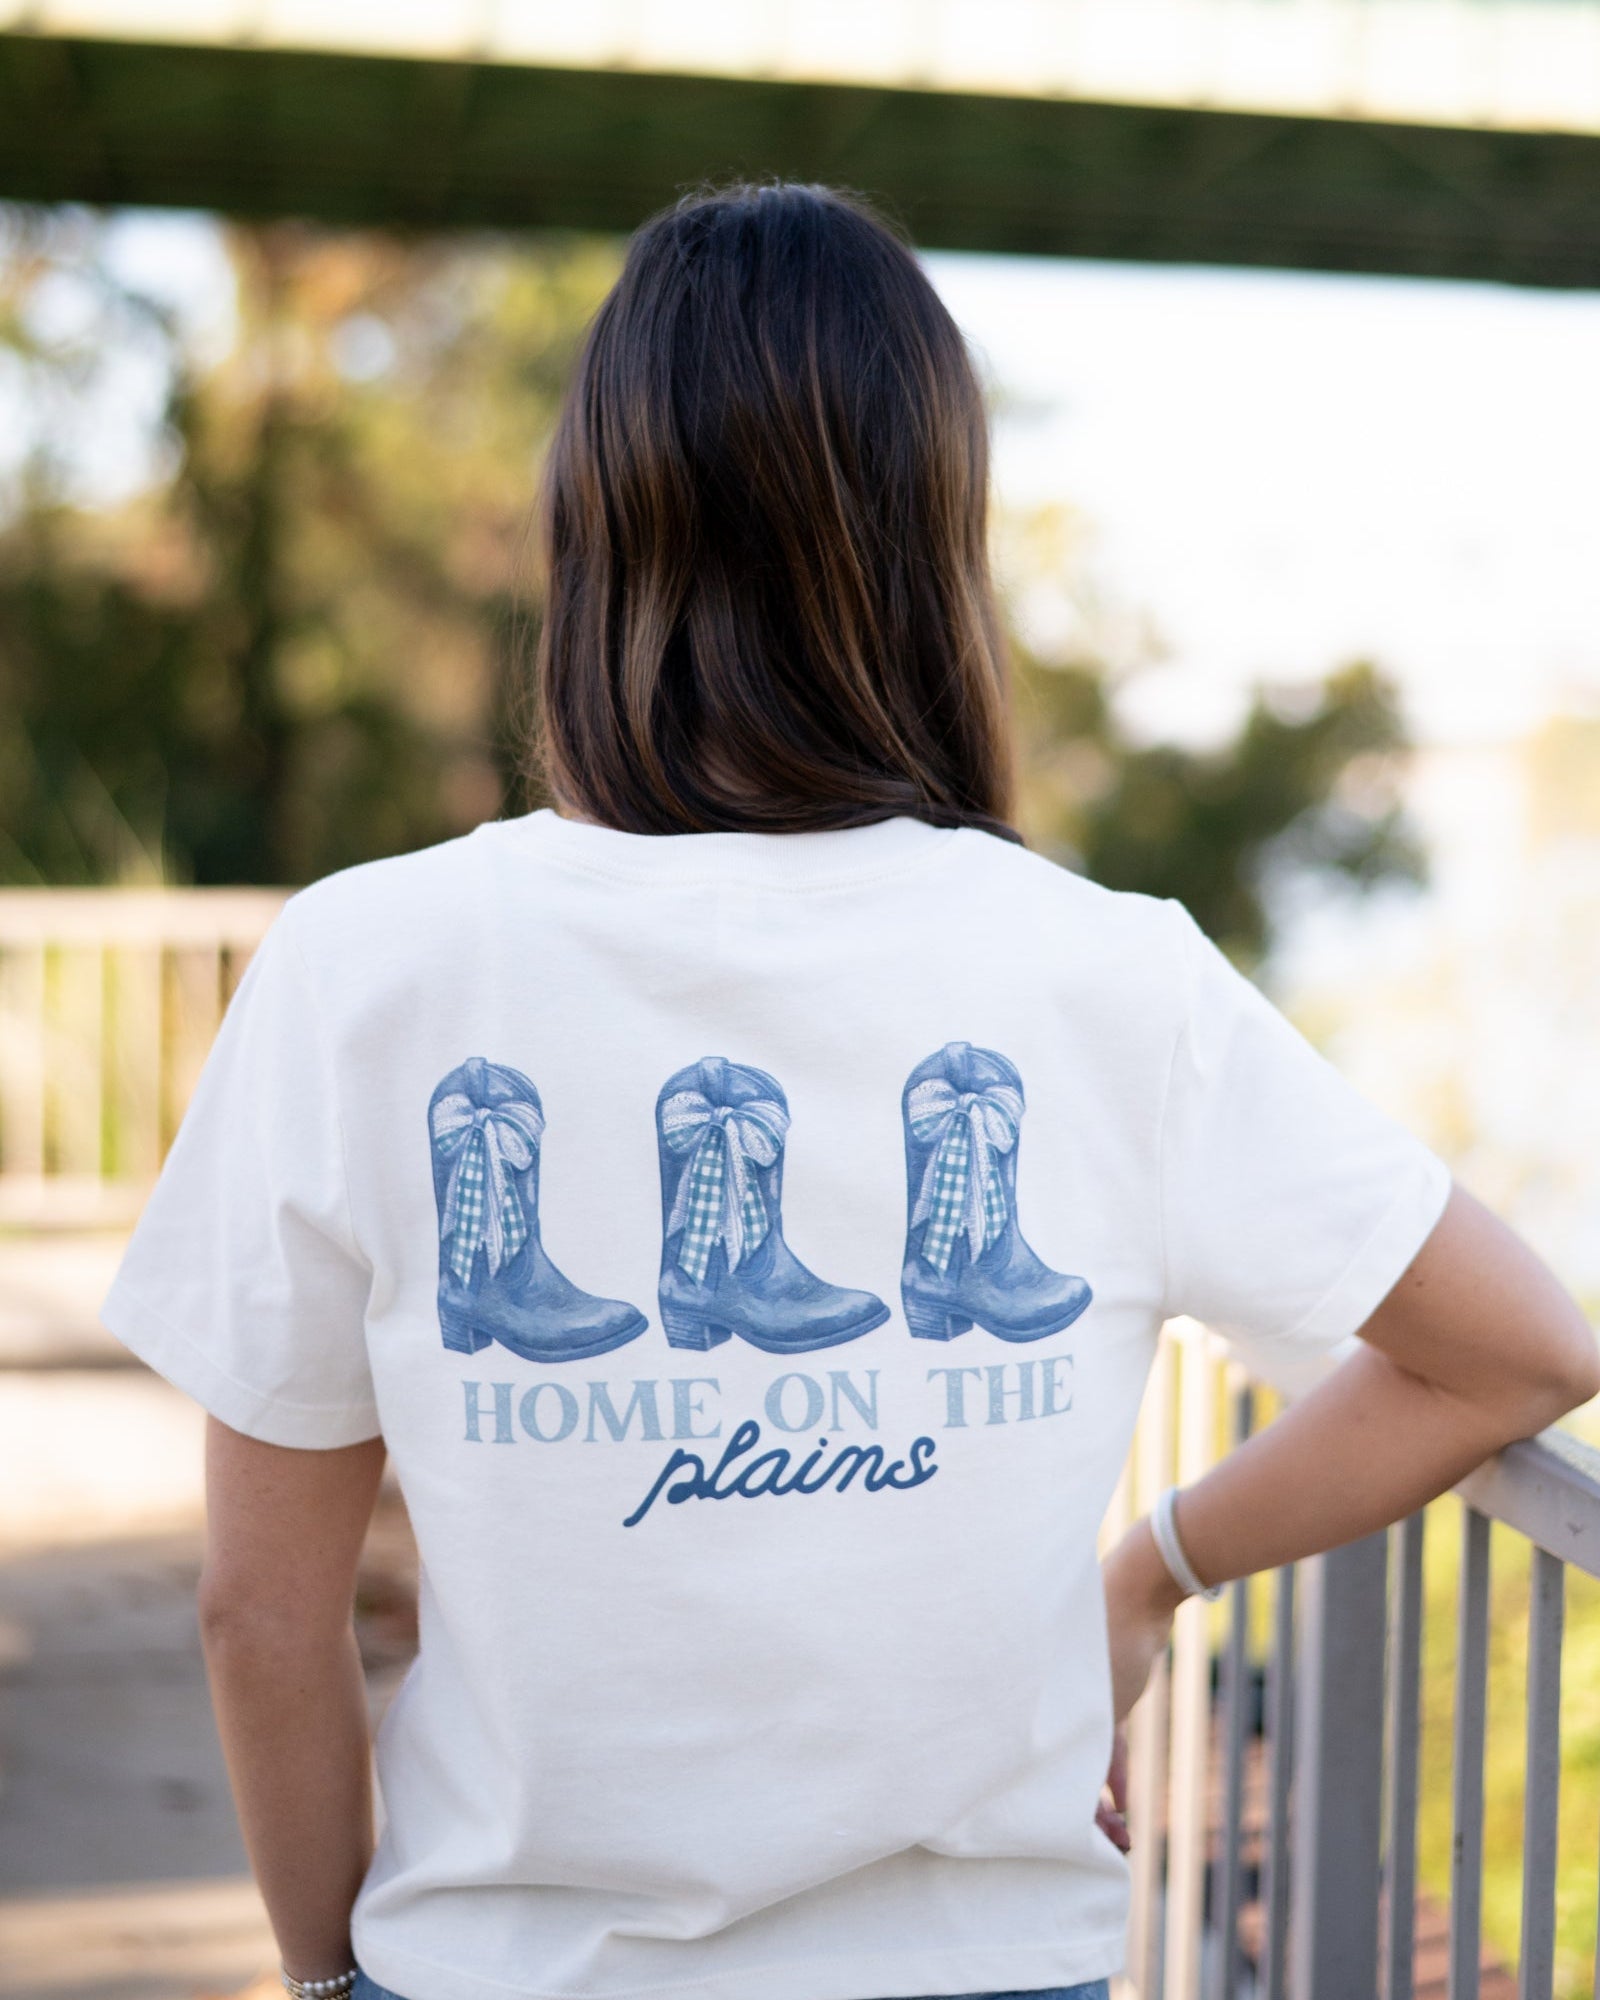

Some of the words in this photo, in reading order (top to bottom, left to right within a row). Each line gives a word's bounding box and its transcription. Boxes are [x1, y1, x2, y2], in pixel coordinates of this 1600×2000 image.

[460, 1377, 723, 1444] HOME
[763, 1369, 881, 1433] ON
[926, 1354, 1075, 1429] THE
[622, 1419, 939, 1528] plains
